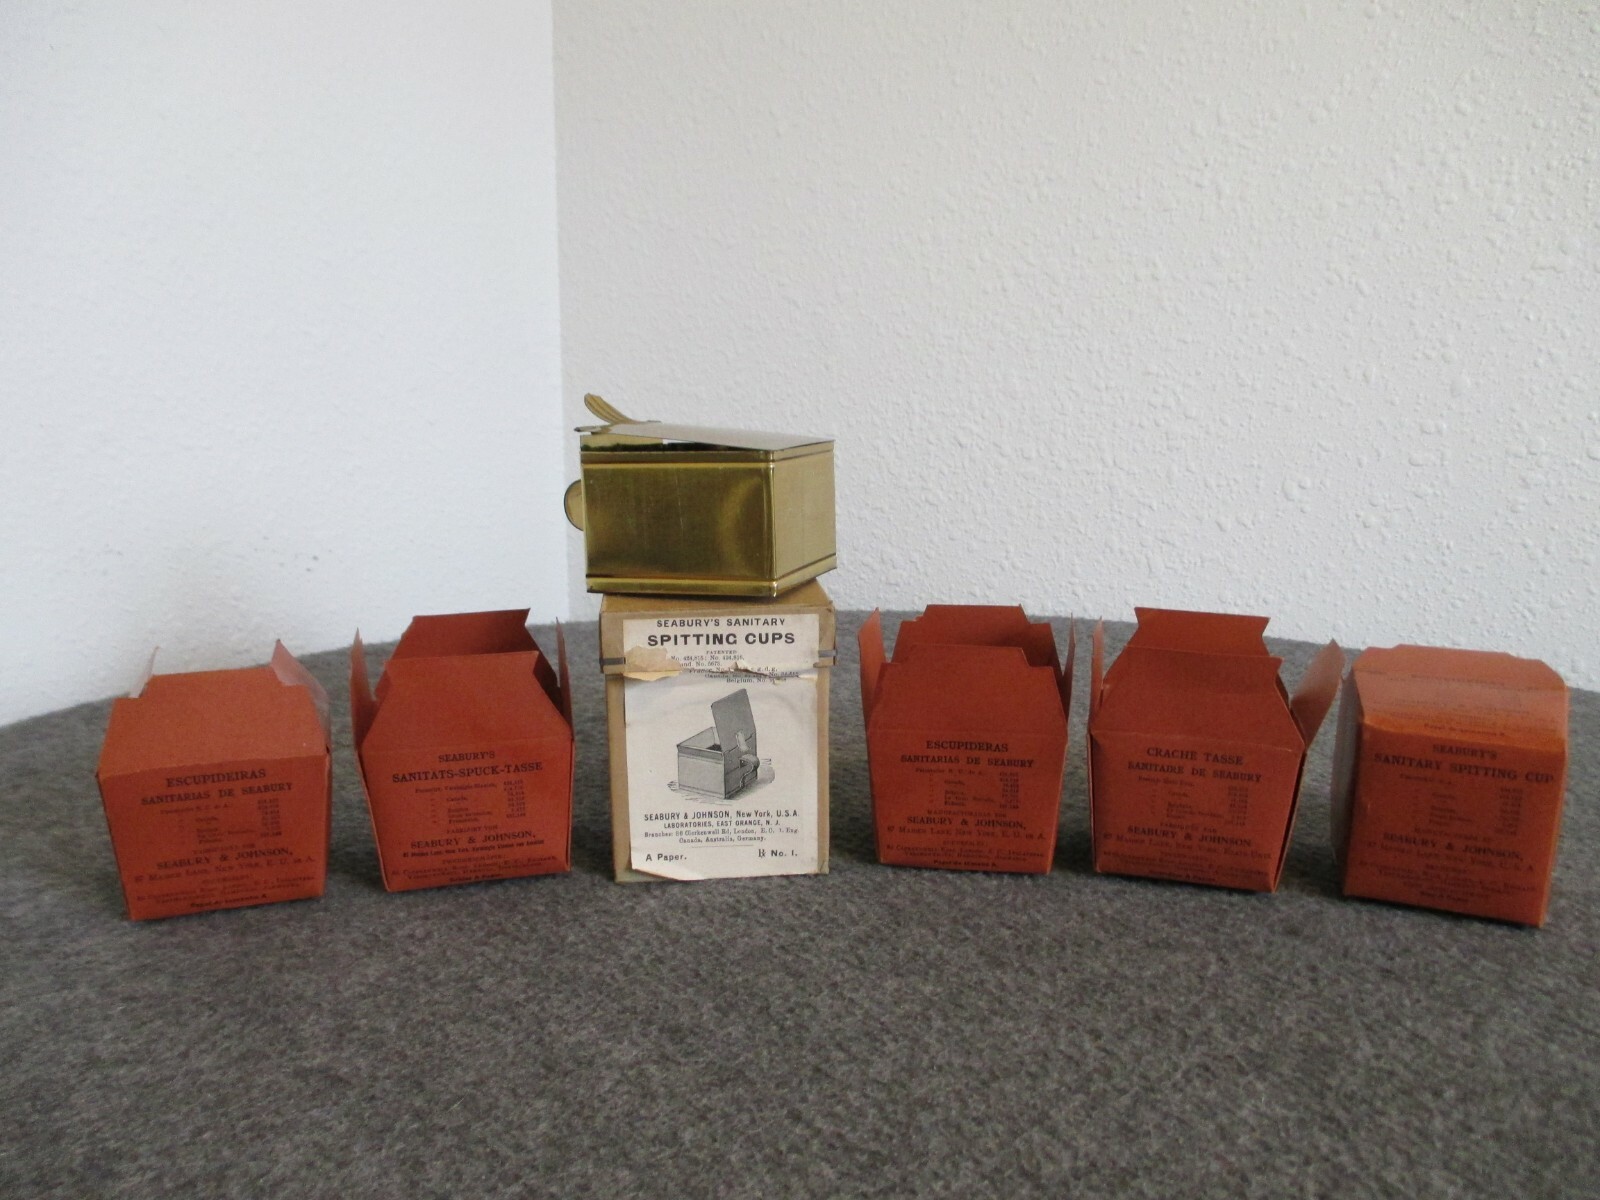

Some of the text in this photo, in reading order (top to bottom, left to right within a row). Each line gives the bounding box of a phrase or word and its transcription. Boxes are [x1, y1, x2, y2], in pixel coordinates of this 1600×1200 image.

[657, 617, 786, 628] SEABURY'S SANITARY
[647, 632, 795, 646] SPITTING CUPS
[926, 740, 1008, 753] ESCUPIDERAS
[438, 751, 495, 763] SEABURY'S
[901, 754, 1034, 768] SANITARIAS DE SEABURY
[1146, 747, 1244, 765] CRACHE TASSE
[1128, 761, 1262, 783] SANITAIRE DE SEABURY
[1374, 752, 1442, 771] SANITARY
[1450, 762, 1518, 780] SPITTING
[1525, 771, 1554, 784] CUP
[166, 768, 266, 788] ESCUPIDEIRAS
[141, 782, 292, 806] SANITARIAS DE SEABURY
[644, 812, 680, 821] SEABURY
[692, 810, 732, 820] JOHNSON,
[754, 810, 773, 818] York,
[906, 816, 953, 826] SEABURY
[975, 819, 1027, 830] JOHNSON,
[410, 838, 461, 849] SEABURY
[467, 836, 477, 844] &
[482, 830, 536, 843] JOHNSON,
[1127, 825, 1177, 839] SEABURY
[1184, 832, 1192, 840] &
[1445, 842, 1454, 851] &
[156, 856, 210, 870] SEABURY
[657, 854, 687, 862] Paper.
